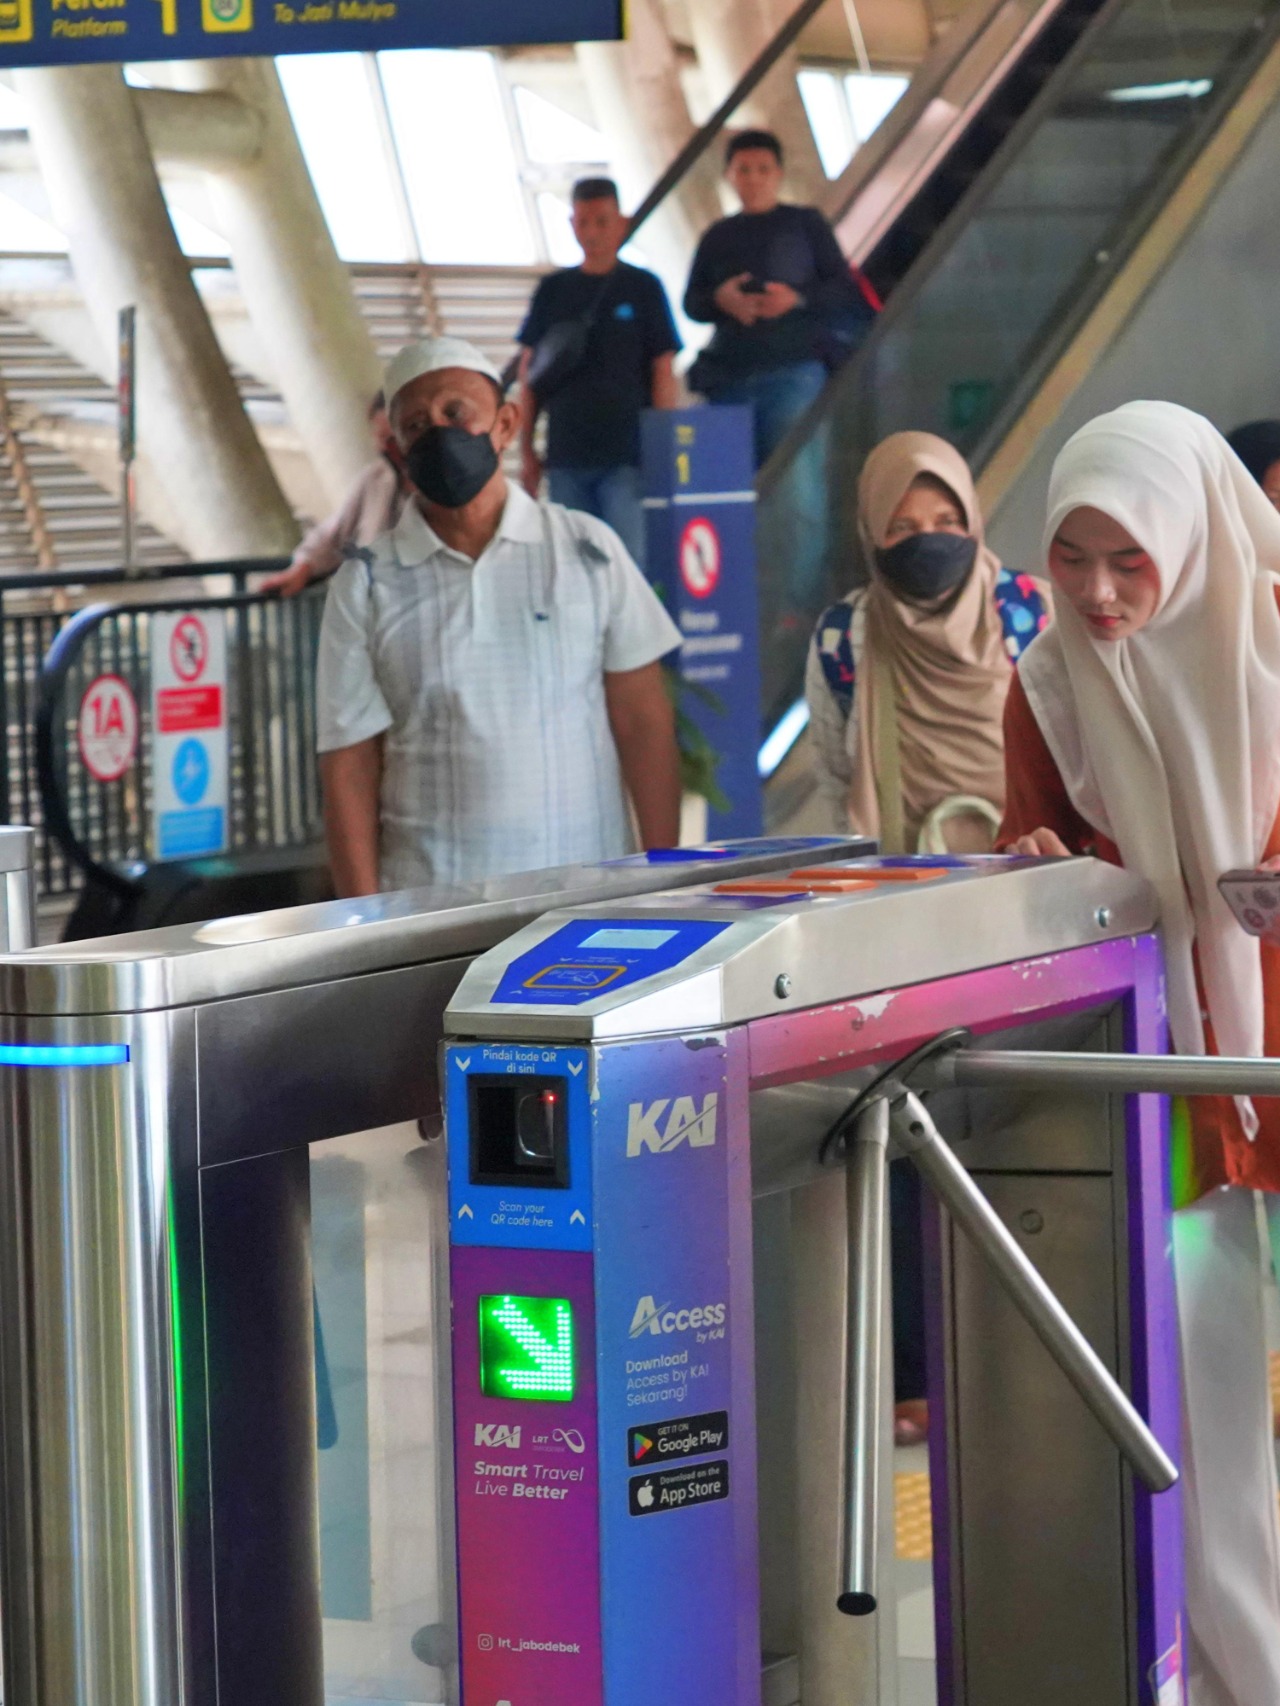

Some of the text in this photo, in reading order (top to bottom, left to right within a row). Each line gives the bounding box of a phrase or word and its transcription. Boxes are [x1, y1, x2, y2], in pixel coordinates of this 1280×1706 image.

[274, 3, 294, 23] To
[299, 1, 332, 21] Jati
[52, 18, 126, 37] Platform
[90, 694, 125, 738] 1A
[483, 1049, 557, 1062] Pindai kode QR
[507, 1063, 535, 1074] di sini
[626, 1092, 718, 1158] KAI
[498, 1201, 545, 1215] Scan your
[491, 1213, 554, 1227] QR code here
[628, 1295, 726, 1339] Access
[696, 1327, 725, 1344] by KAI
[626, 1350, 688, 1374] Download
[627, 1364, 709, 1390] Access by KAI
[627, 1385, 688, 1406] Sekarang!
[474, 1423, 548, 1448] KAI LRT
[658, 1426, 671, 1436] GET
[658, 1430, 723, 1452] Google Play
[474, 1461, 584, 1481] Smart Travel
[660, 1466, 719, 1485] Download on the
[475, 1480, 568, 1499] Live Better
[660, 1481, 721, 1506] App Store
[498, 1637, 580, 1653] lrt_jabodebek
